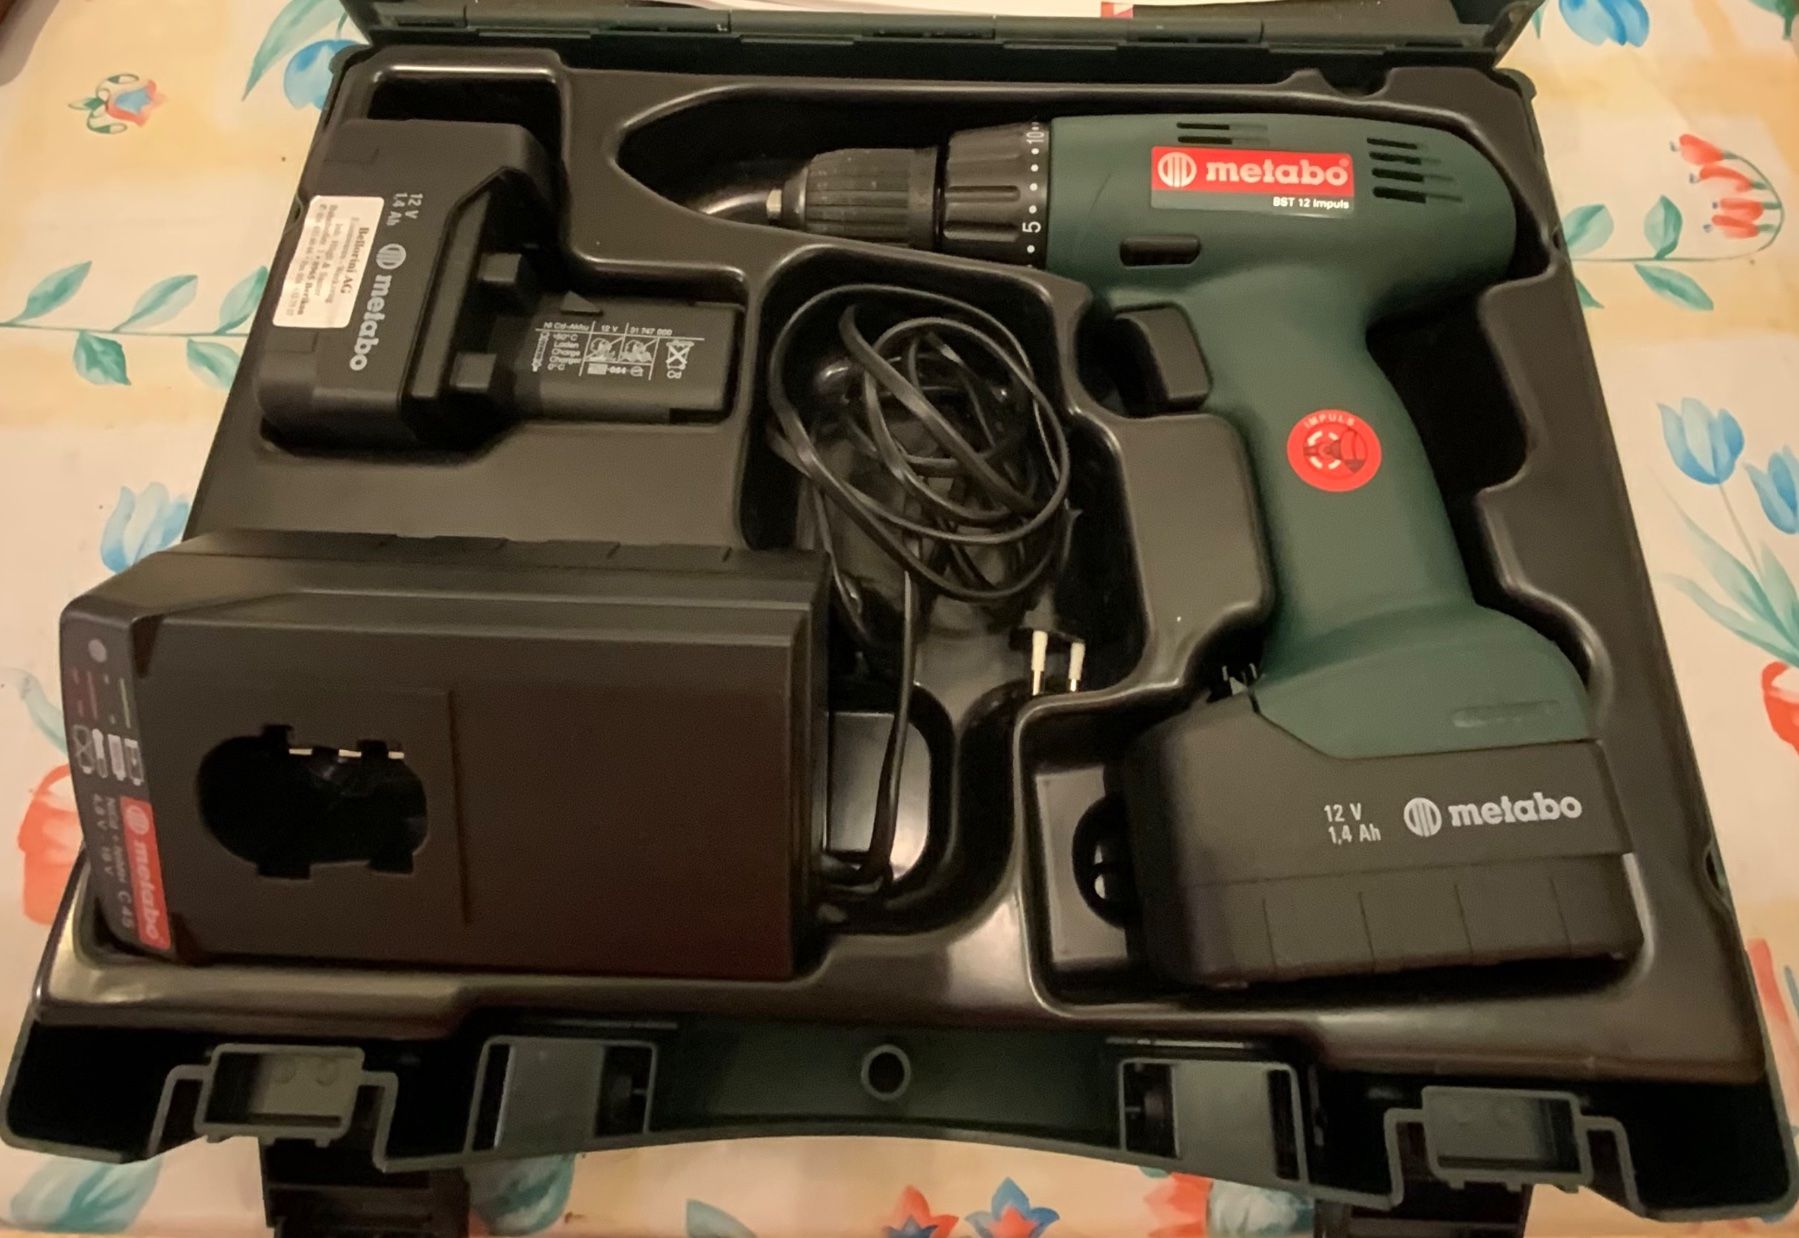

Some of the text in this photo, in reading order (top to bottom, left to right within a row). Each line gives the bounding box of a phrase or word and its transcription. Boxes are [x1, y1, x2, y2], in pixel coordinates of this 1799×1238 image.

[1205, 158, 1349, 187] metabo
[405, 193, 423, 220] 12 V
[1272, 196, 1295, 208] BST
[1298, 198, 1310, 209] 12
[386, 211, 402, 227] Ah
[1021, 221, 1042, 234] 5
[345, 226, 370, 273] Bellorini
[339, 275, 354, 295] AG
[349, 274, 393, 371] metabo
[666, 370, 682, 379] Cd
[1324, 802, 1362, 822] 12 V
[1447, 791, 1583, 827] metabo
[1328, 823, 1381, 845] 1,4 Ah
[133, 840, 161, 940] metabo
